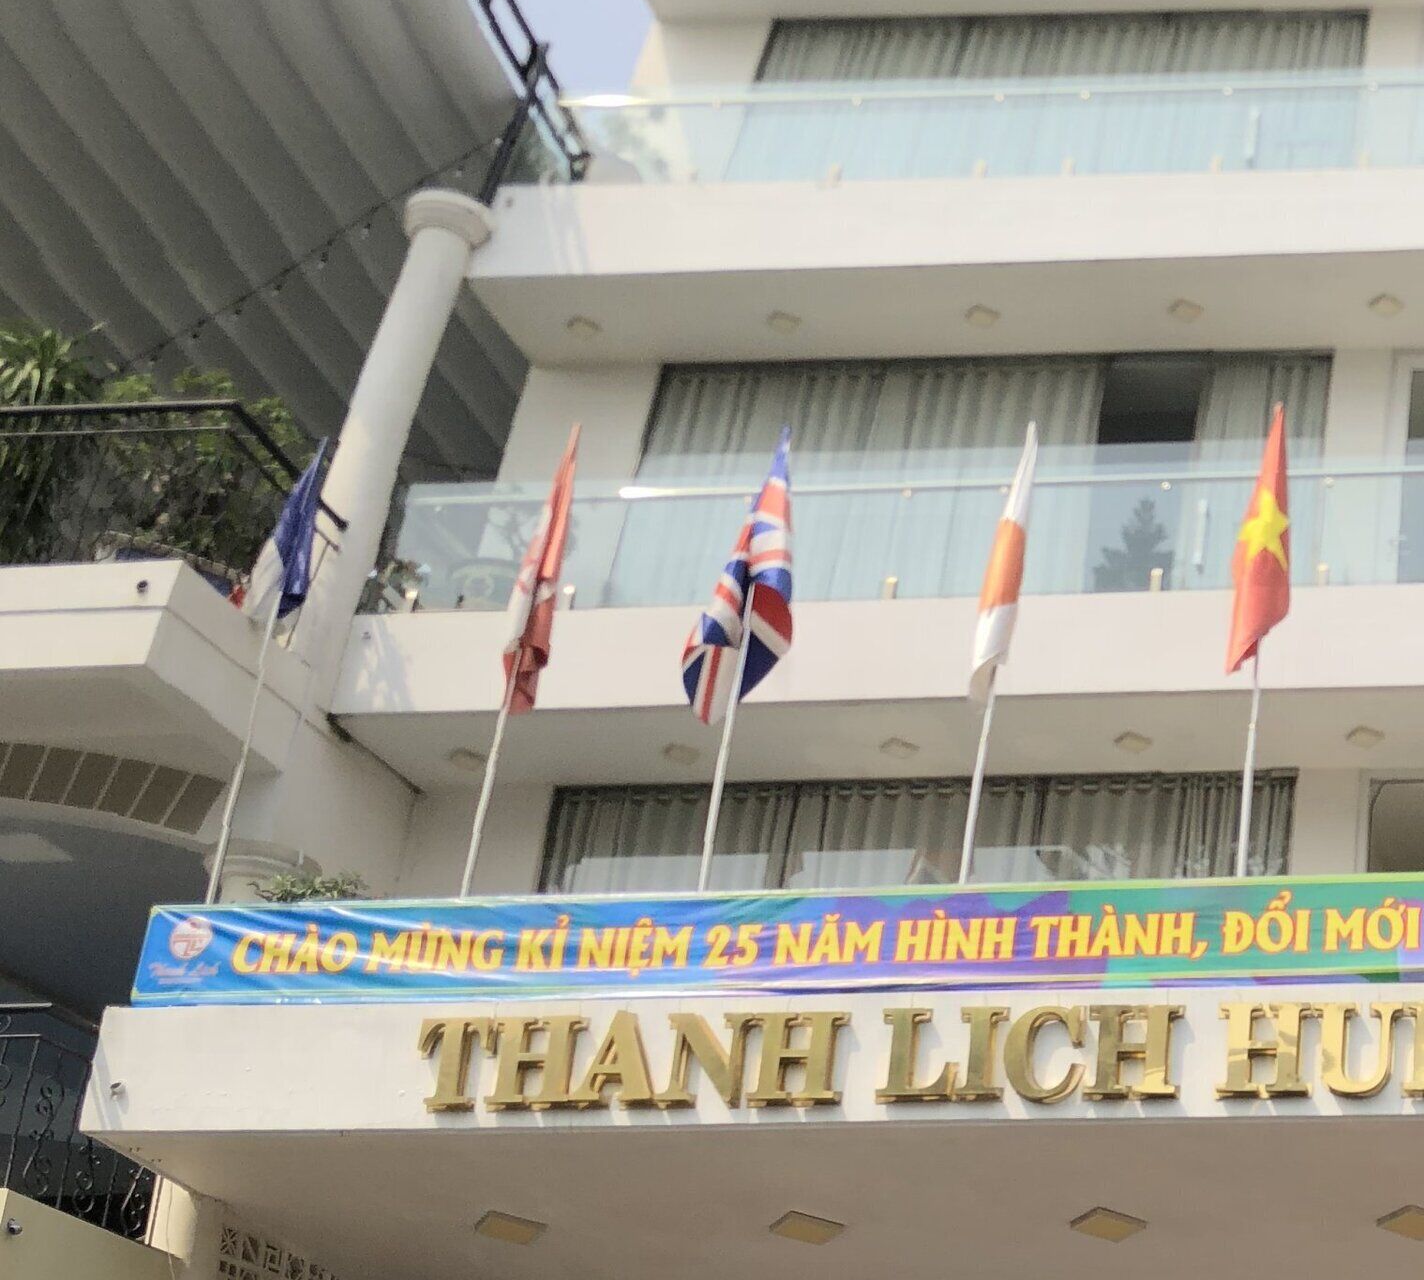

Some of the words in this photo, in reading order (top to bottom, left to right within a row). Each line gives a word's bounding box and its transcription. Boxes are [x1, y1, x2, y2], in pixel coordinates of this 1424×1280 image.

[230, 923, 357, 975] CHÀO
[364, 920, 506, 974] MỪNG
[515, 914, 565, 972] KỈ
[578, 917, 694, 980] NIỆM
[704, 922, 760, 968] 25
[771, 913, 885, 966] NĂM
[895, 909, 1015, 963] HÌNH
[1031, 906, 1208, 959] THÀNH,
[1221, 890, 1312, 955] ĐỔI
[1322, 897, 1421, 951] MỚI
[417, 1008, 851, 1114] THANH
[874, 1003, 1188, 1105] LICH
